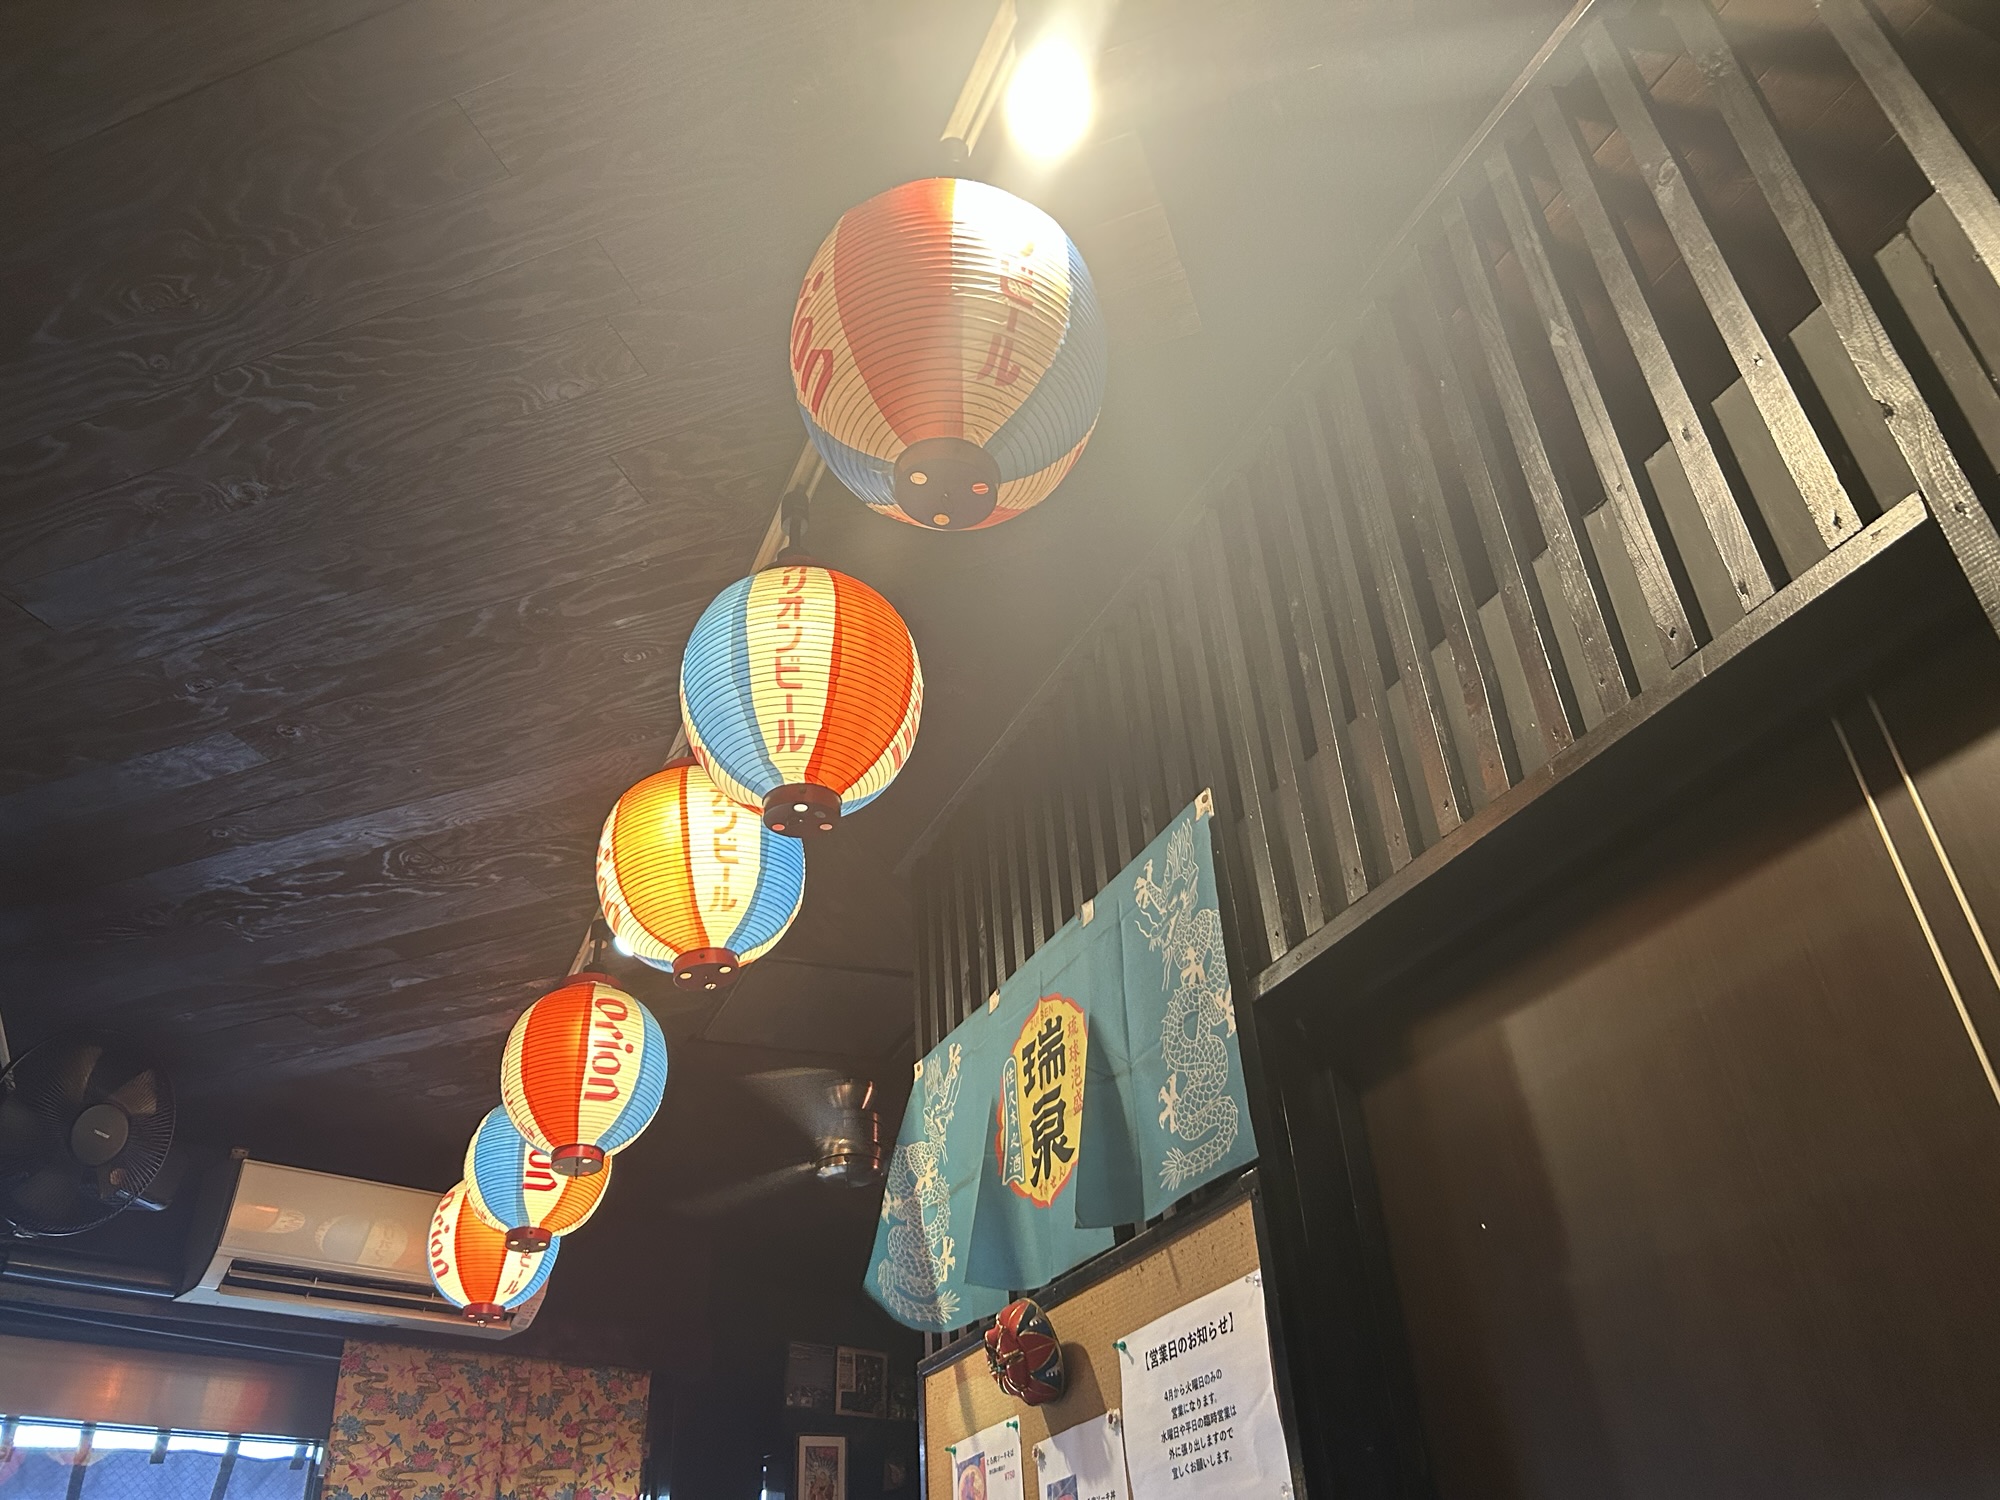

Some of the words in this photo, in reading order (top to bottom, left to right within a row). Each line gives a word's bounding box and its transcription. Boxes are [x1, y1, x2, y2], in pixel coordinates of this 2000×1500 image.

[583, 997, 629, 1102] Orion
[1066, 1014, 1084, 1117] 琉球泡盛
[1021, 1014, 1076, 1188] 瑞泉
[430, 1190, 456, 1279] Orion
[1144, 1311, 1234, 1371] 【営業日のお知らせ】
[1163, 1368, 1223, 1402] 4月から火曜日のみの
[1171, 1391, 1218, 1420] 営業になります。
[1160, 1404, 1237, 1443] 水曜日や平日の臨時営業は
[1168, 1426, 1234, 1460] 外に張り出しますので
